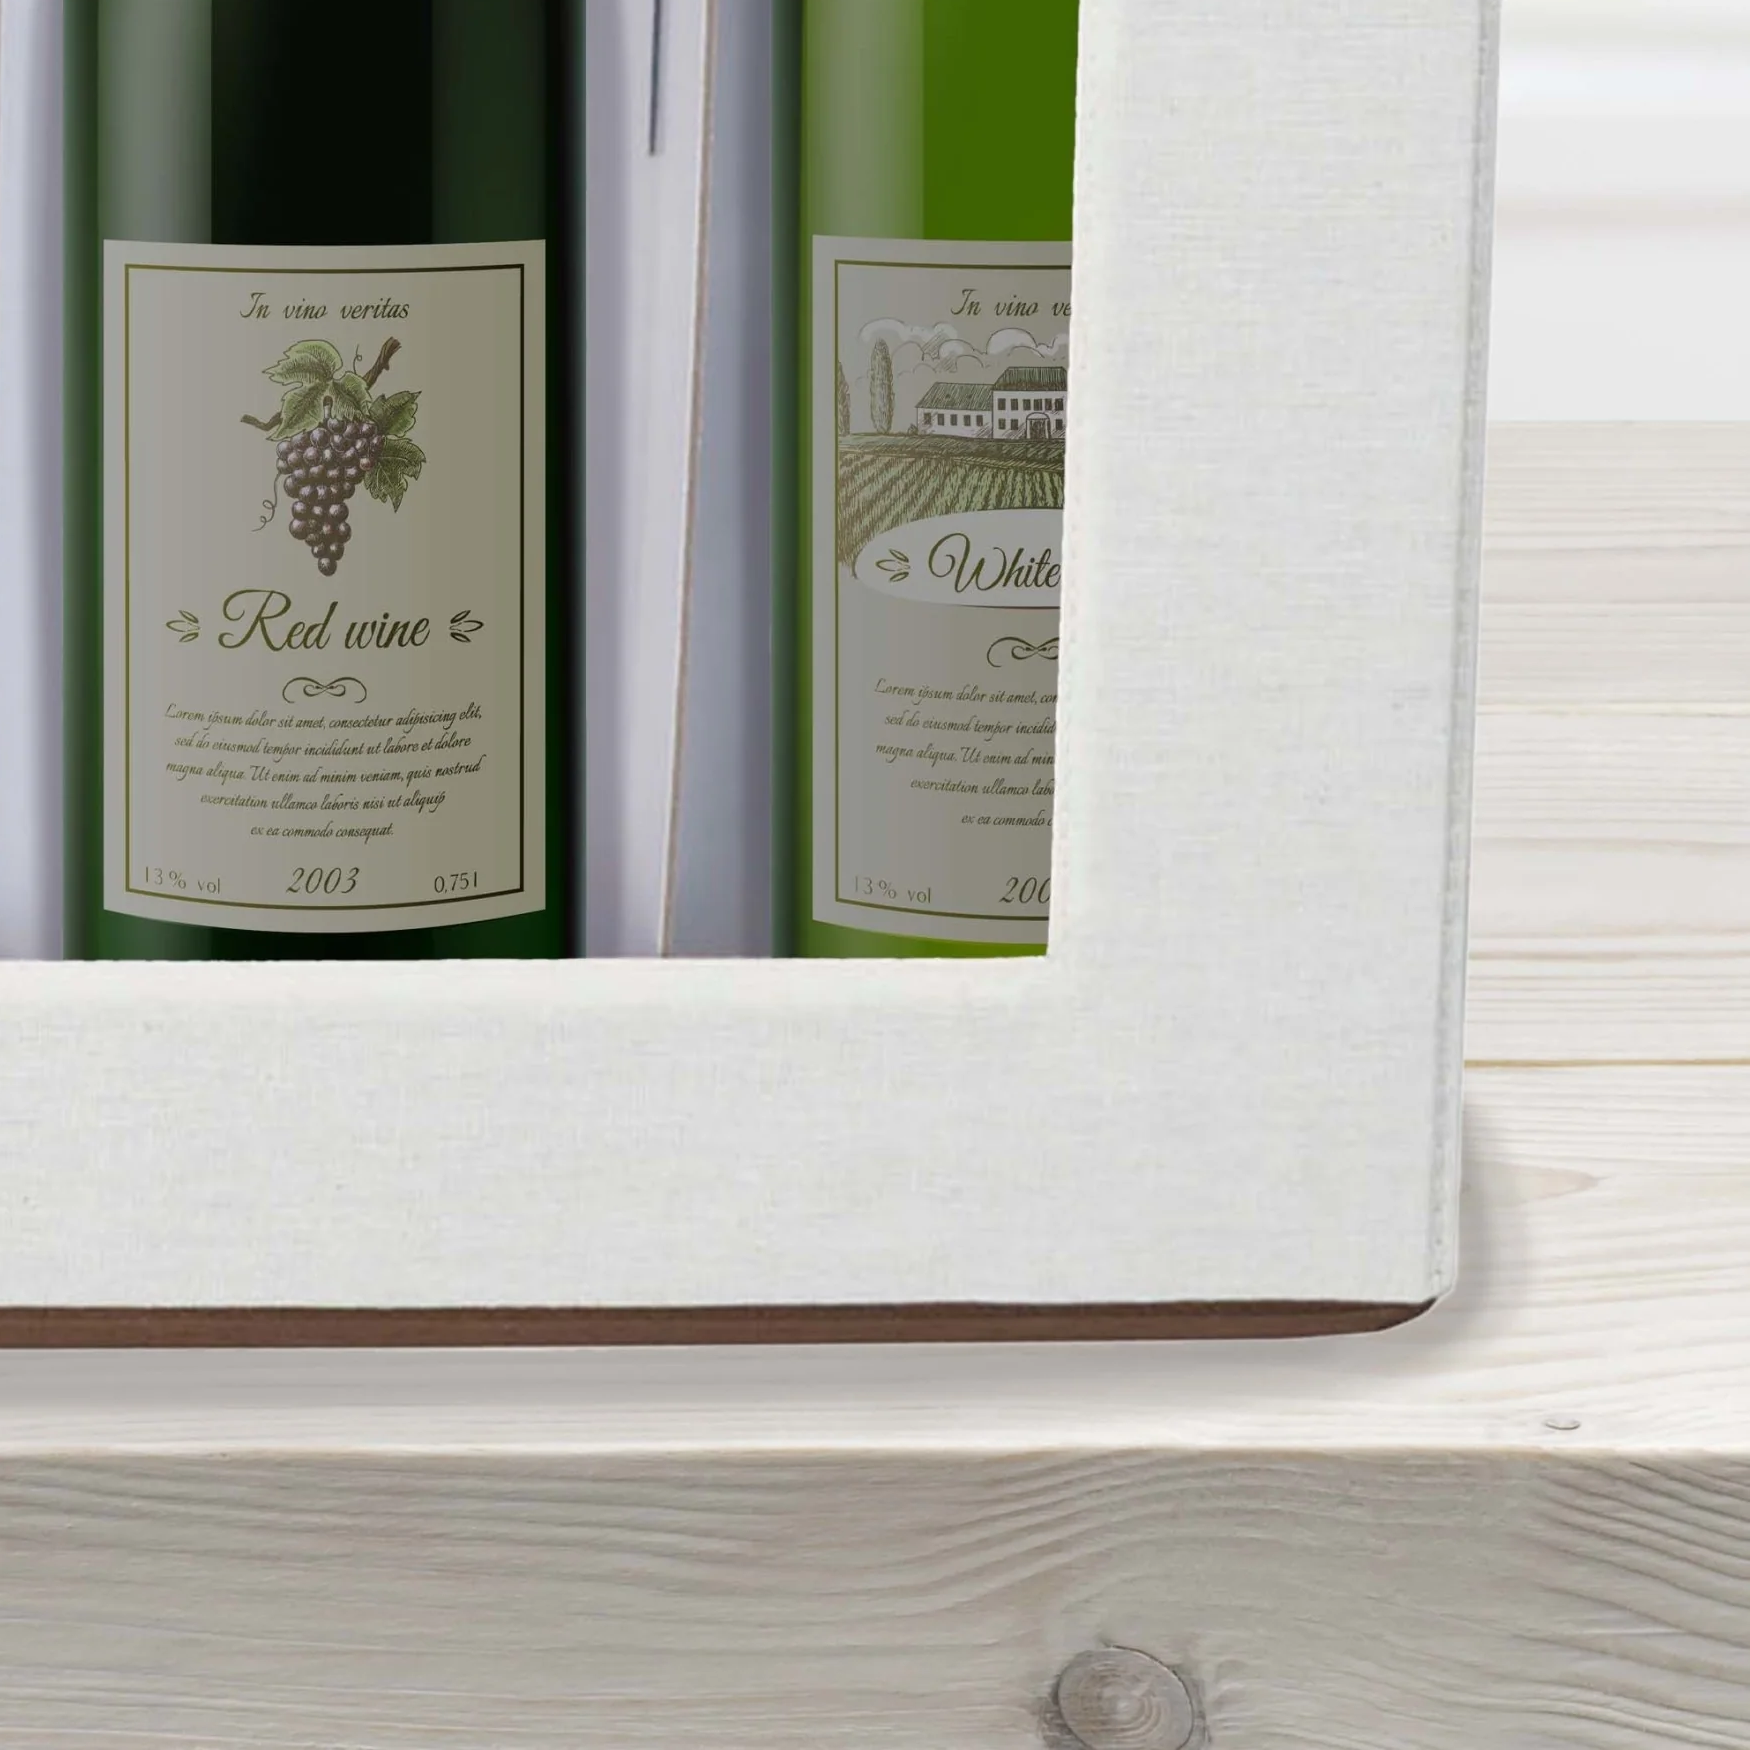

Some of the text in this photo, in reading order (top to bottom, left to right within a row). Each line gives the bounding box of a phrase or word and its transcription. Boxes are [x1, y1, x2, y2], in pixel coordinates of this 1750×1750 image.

[240, 292, 410, 319] In vino veritas
[951, 288, 981, 316] In
[995, 294, 1038, 316] vino
[928, 533, 1061, 592] White
[218, 589, 431, 651] Red wine
[875, 678, 915, 697] Lorem
[911, 684, 953, 705] ipsum
[956, 684, 986, 702] dolor
[989, 690, 1005, 703] sit
[1006, 691, 1037, 705] amet,
[164, 701, 482, 733] Lorem ipsum dolor sit amet, consectetur adipisicing elit,
[885, 710, 909, 725] sed
[906, 710, 921, 726] do
[922, 715, 977, 731] eiusmod
[974, 720, 1014, 742] tempor
[174, 731, 471, 763] sed do eiusmod tempor incididunt ut labore et dolore
[876, 744, 914, 763] magna
[960, 746, 981, 763] Ut
[983, 752, 1012, 764] enim
[1014, 747, 1034, 764] ad
[166, 762, 203, 781] magna
[250, 765, 270, 781] Ut
[271, 770, 300, 782] enim
[302, 766, 323, 783] ad
[320, 770, 357, 783] minim
[360, 768, 404, 782] veniam,
[406, 765, 432, 787] quis
[435, 754, 487, 777] nostrud
[910, 778, 978, 794] exercitation
[982, 778, 1028, 795] ullamco
[200, 789, 446, 813] exercitation ullamco laboris nisi ut aliquip
[250, 825, 264, 836] ex
[266, 826, 280, 836] ea
[282, 820, 334, 838] commodo
[961, 814, 975, 825] ex
[978, 815, 991, 825] ea
[993, 809, 1045, 826] commodo
[197, 877, 220, 894] vol
[286, 867, 360, 895] 2003
[907, 888, 931, 903] vol
